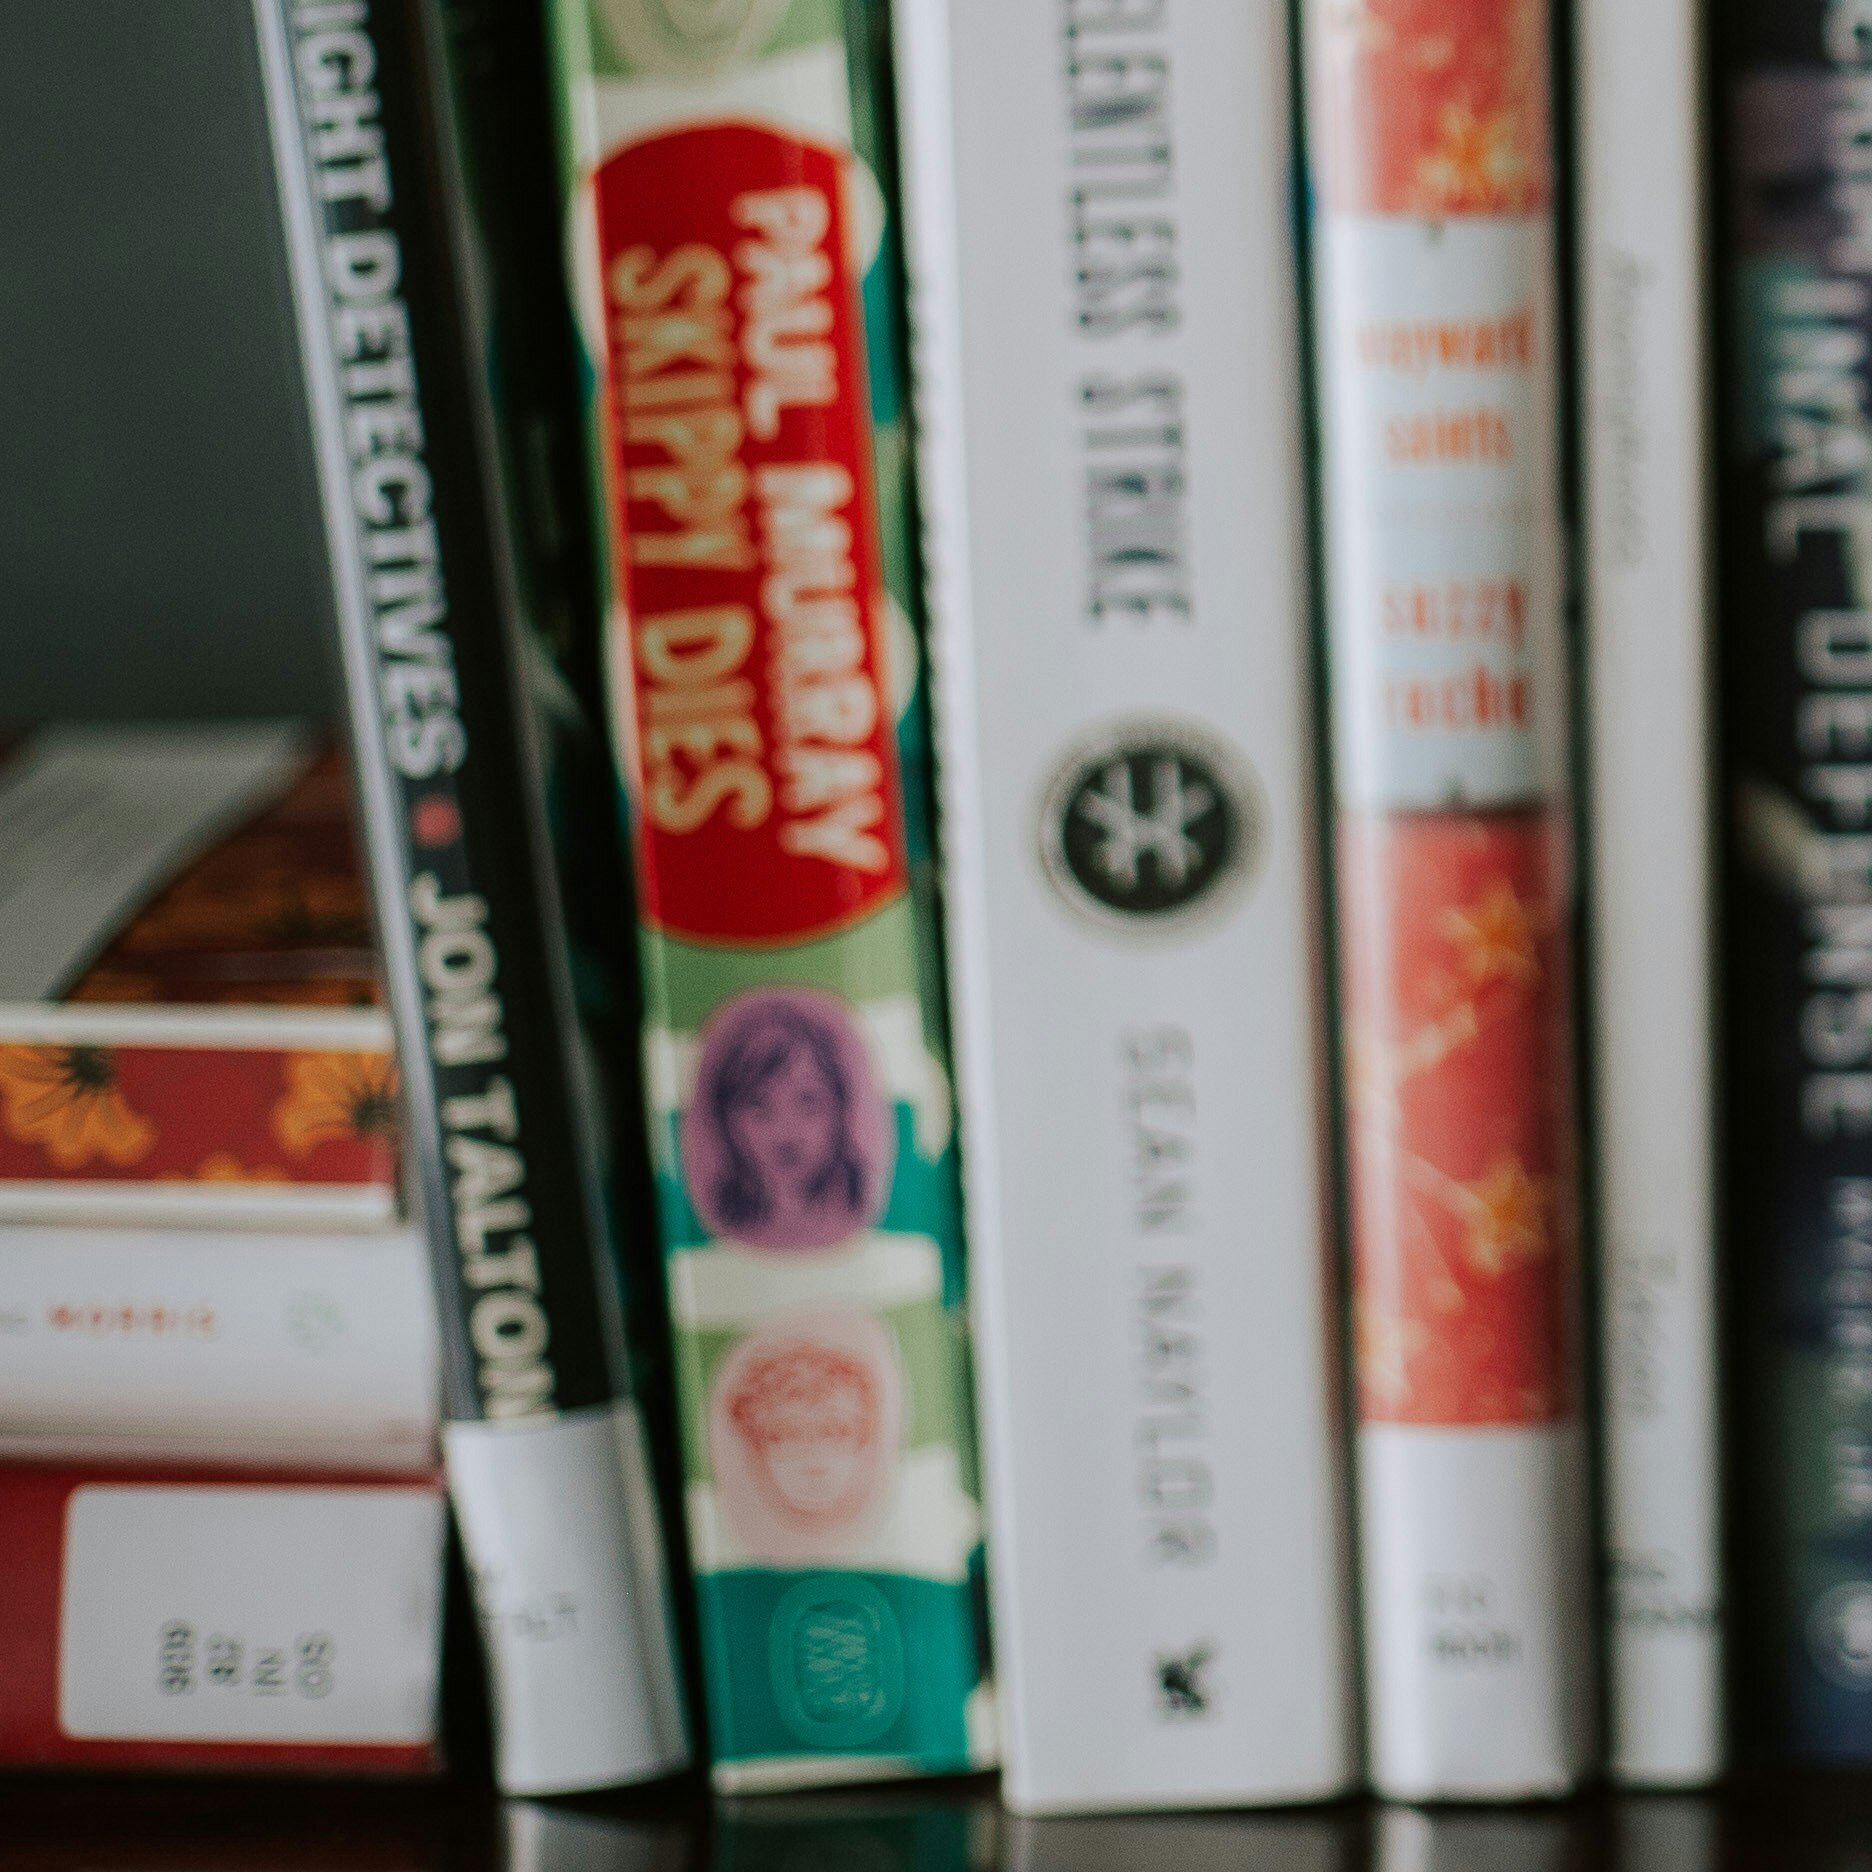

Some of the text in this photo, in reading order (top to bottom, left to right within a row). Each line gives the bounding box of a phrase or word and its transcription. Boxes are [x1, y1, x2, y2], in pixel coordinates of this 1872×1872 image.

[333, 224, 466, 780] DETECTIVES
[612, 245, 773, 835] SKIPPY DIES
[731, 184, 890, 874] PAUL MURRAY
[1077, 367, 1191, 629] STRIKE
[408, 873, 558, 1418] JON TALTON
[1119, 1023, 1217, 1574] SEAN NAYLOR
